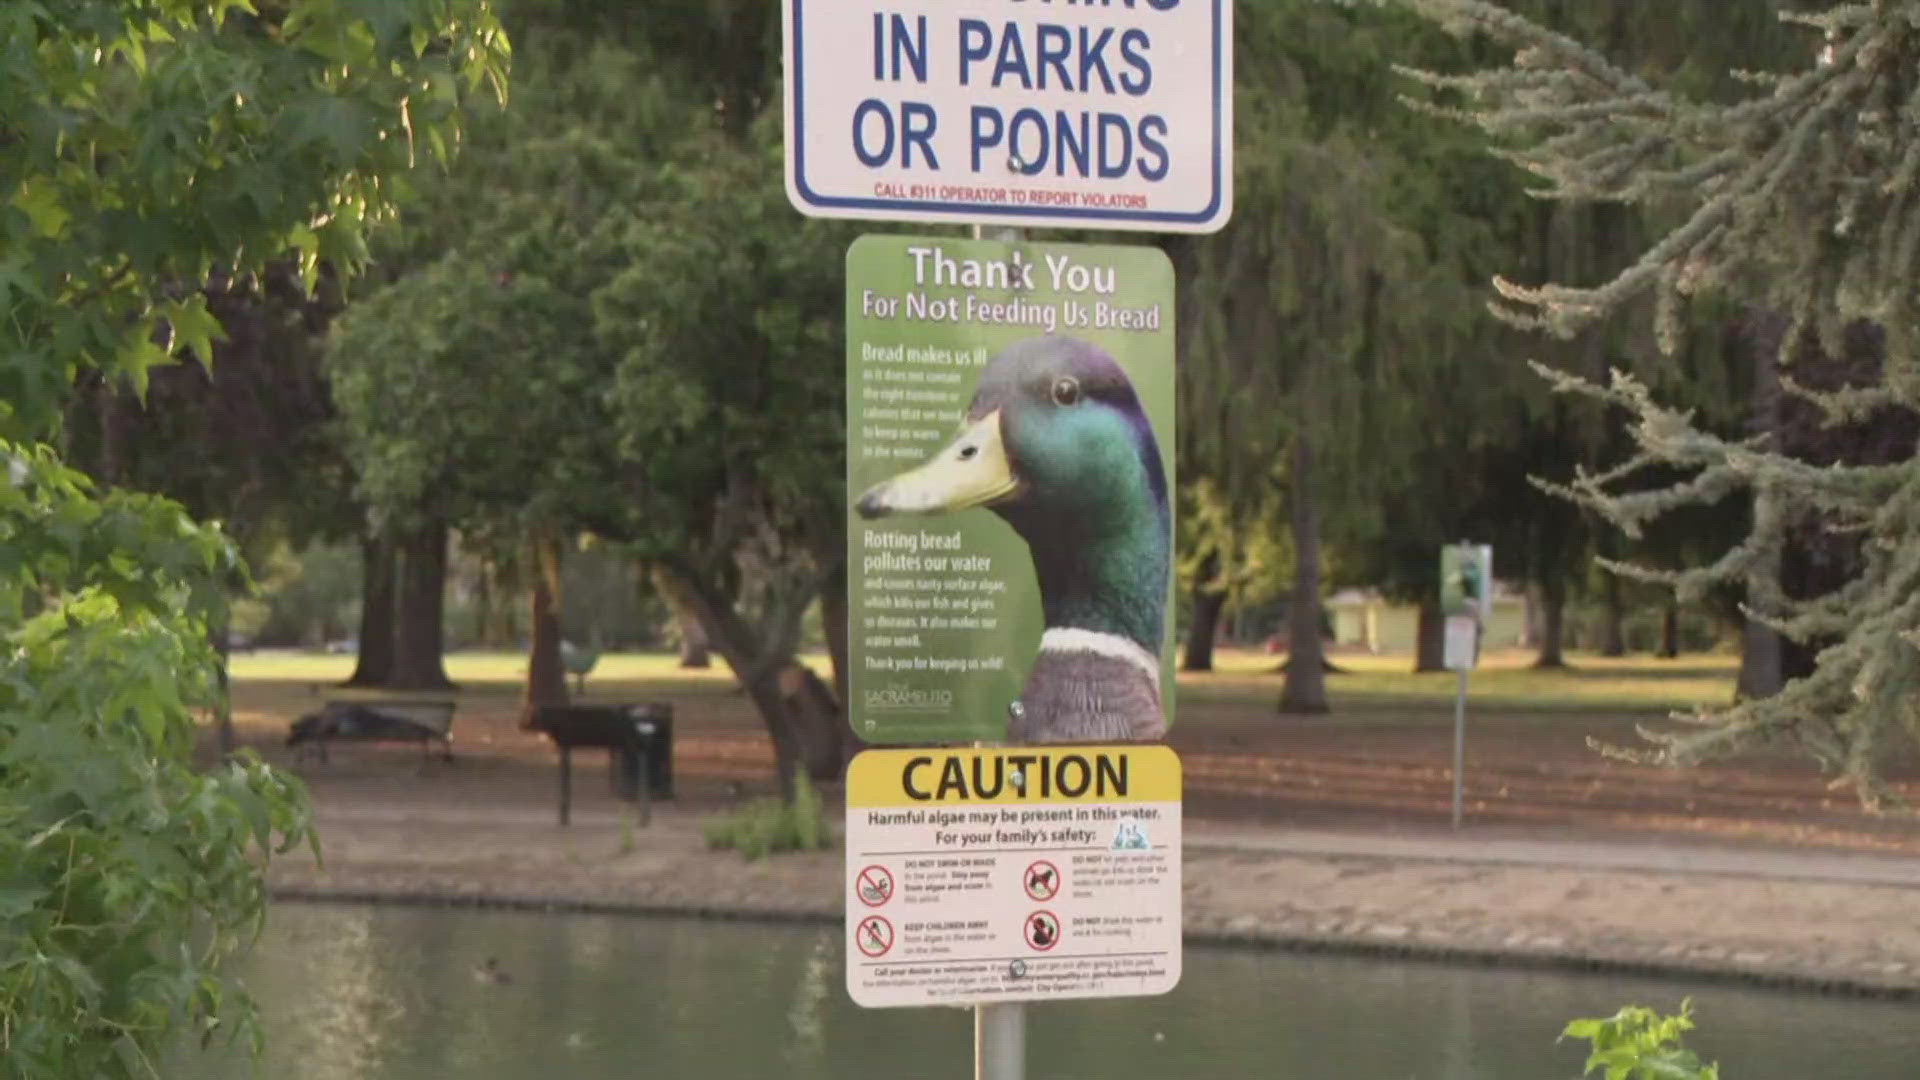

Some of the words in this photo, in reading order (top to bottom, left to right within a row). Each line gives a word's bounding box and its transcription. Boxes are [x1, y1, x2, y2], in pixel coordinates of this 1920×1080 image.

[873, 12, 927, 83] IN
[958, 18, 1153, 96] PARKS
[852, 98, 940, 171] OR
[970, 105, 1170, 182] PONDS
[874, 183, 905, 198] CALL
[911, 185, 936, 199] #311
[940, 186, 1006, 202] OPERATOR
[1010, 189, 1026, 203] TO
[1030, 190, 1078, 206] REPORT
[1082, 192, 1147, 208] VIOLATORS
[908, 247, 1034, 289] Thank
[1046, 255, 1115, 293] You
[863, 289, 898, 317] For
[906, 292, 958, 320] Not
[967, 296, 1056, 331] Feeding
[1064, 301, 1088, 327] Us
[1095, 302, 1159, 329] Bread
[862, 342, 903, 361] Bread
[907, 344, 951, 364] makes
[955, 350, 970, 365] us
[973, 347, 986, 365] ill
[864, 530, 917, 553] Rotting
[920, 530, 961, 549] bread
[864, 552, 921, 575] pollutes
[924, 556, 947, 571] our
[951, 555, 991, 572] water
[902, 754, 1128, 800] CAUTION
[868, 810, 925, 825] Harmful
[928, 811, 966, 827] algae
[969, 812, 998, 829] may
[1000, 808, 1018, 823] be
[1021, 809, 1073, 828] present
[1076, 807, 1089, 820] in
[1092, 806, 1117, 820] this
[1120, 808, 1161, 820] water.
[936, 831, 957, 845] For
[961, 834, 992, 850] your
[996, 829, 1047, 847] family's
[1051, 829, 1097, 846] safety:
